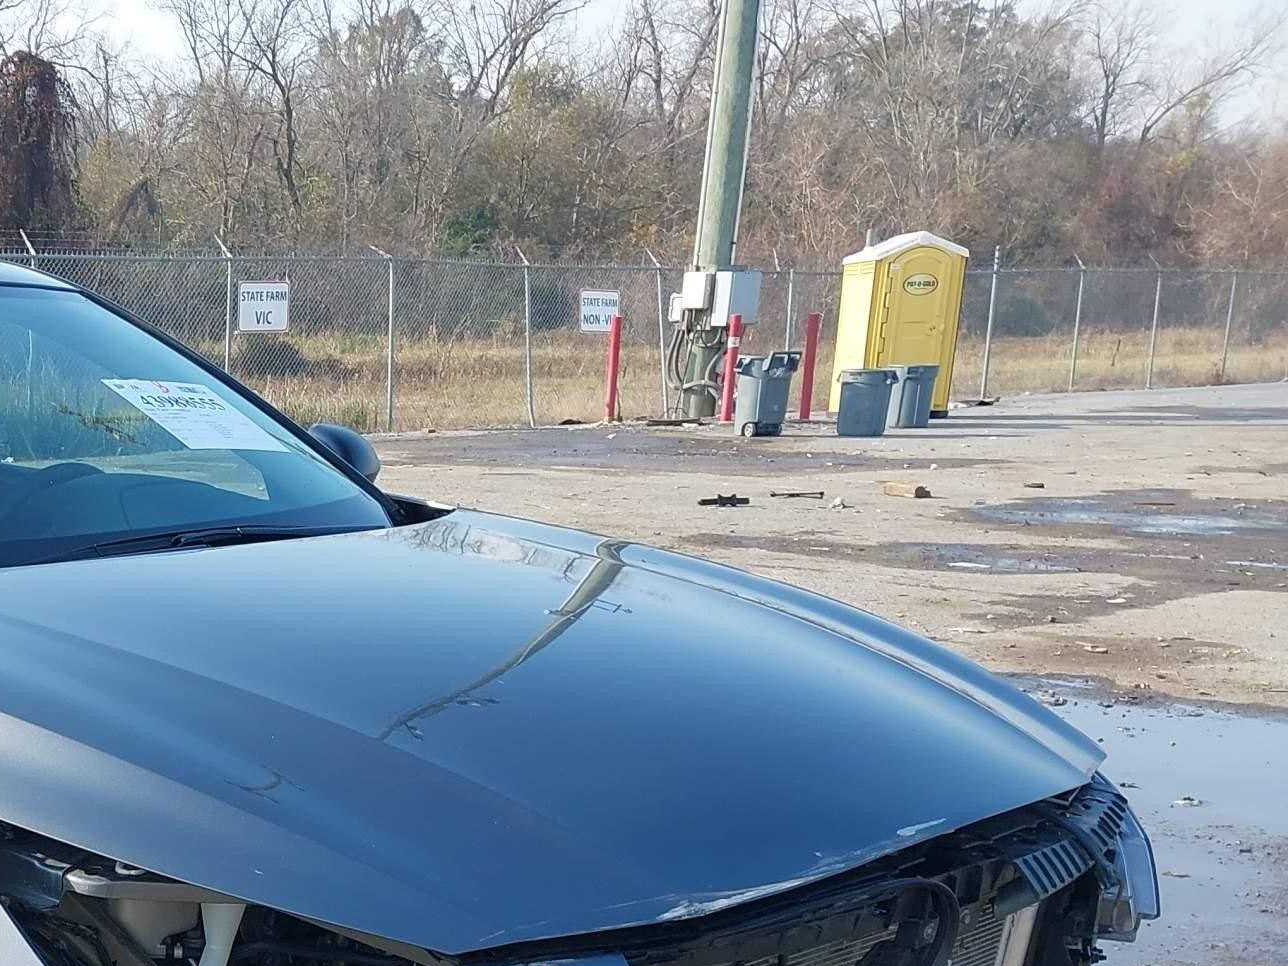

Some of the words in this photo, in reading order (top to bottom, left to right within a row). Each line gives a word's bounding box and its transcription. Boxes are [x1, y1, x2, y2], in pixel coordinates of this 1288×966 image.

[241, 290, 264, 302] STATE
[265, 290, 287, 302] FARM
[582, 297, 601, 307] STATE
[601, 298, 618, 308] FARM
[255, 310, 273, 325] VIC
[583, 313, 617, 325] NON-VI
[139, 394, 226, 411] 43988555
